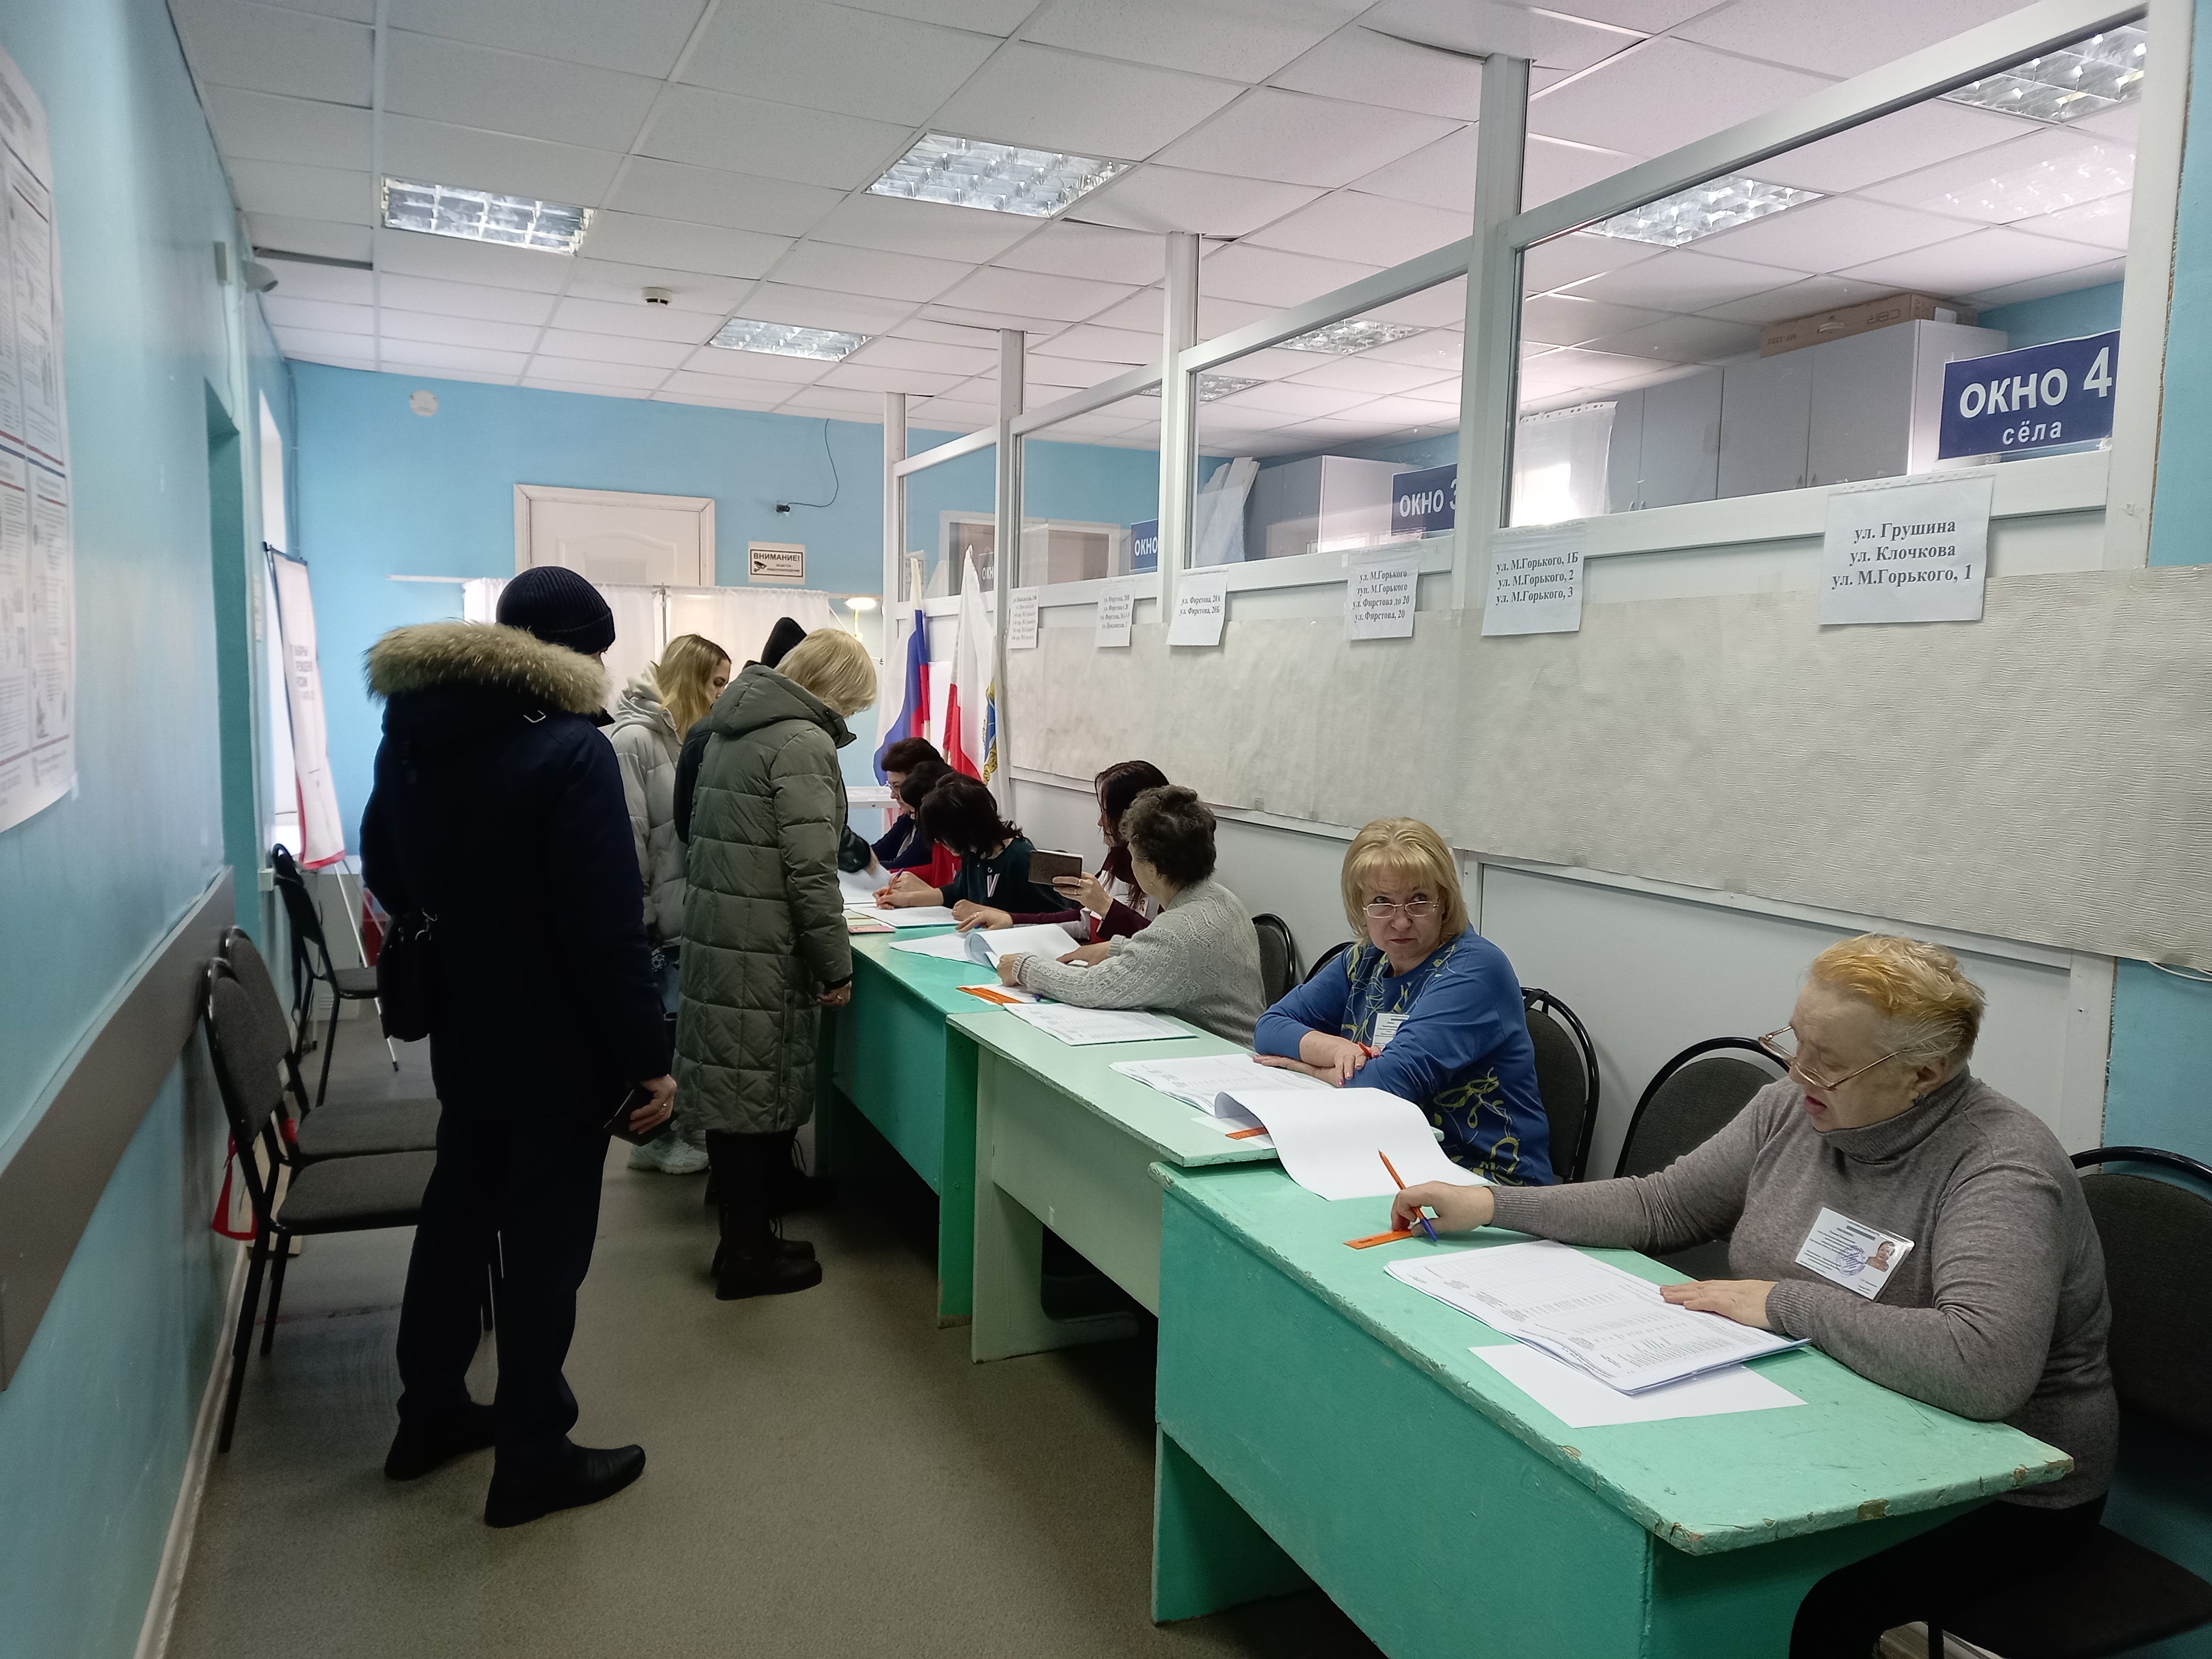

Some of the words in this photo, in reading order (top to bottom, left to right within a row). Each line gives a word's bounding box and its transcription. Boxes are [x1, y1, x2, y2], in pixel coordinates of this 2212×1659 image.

[1959, 368, 2068, 419] ОКНО
[2083, 346, 2113, 398] 4
[2002, 420, 2062, 445] сёла
[1400, 489, 1444, 518] ОКНО
[1854, 528, 1876, 544] ул.
[1880, 520, 1956, 542] Грушина
[1134, 536, 1157, 556] ОКНО
[1849, 551, 1871, 567] ул.
[1875, 544, 1956, 561] Клочкова
[753, 552, 800, 562] ВНИМАНИЕ!
[1496, 563, 1509, 575] ул.
[1510, 556, 1564, 571] М.Горького,
[1567, 551, 1579, 564] 1Б
[982, 566, 994, 581] ОКН
[1359, 575, 1369, 583] ул.
[1370, 570, 1407, 582] М.Горького
[1497, 578, 1511, 590] ул.
[1512, 572, 1567, 587] М.Горького,
[1568, 569, 1574, 581] 2
[1832, 574, 1853, 590] ул.
[1857, 568, 1959, 588] М.Горького,
[1964, 564, 1972, 580] 1
[1370, 584, 1408, 595] М.Горького
[1495, 594, 1509, 606] ул.
[1511, 590, 1566, 604] М.Горького,
[1567, 586, 1574, 598] 3
[1353, 601, 1361, 610] ул.
[1363, 598, 1393, 609] Фирстова
[1402, 595, 1410, 605] 20
[1354, 614, 1364, 623] ул.
[1364, 611, 1396, 622] Фирстова,
[1397, 609, 1405, 619] 20
